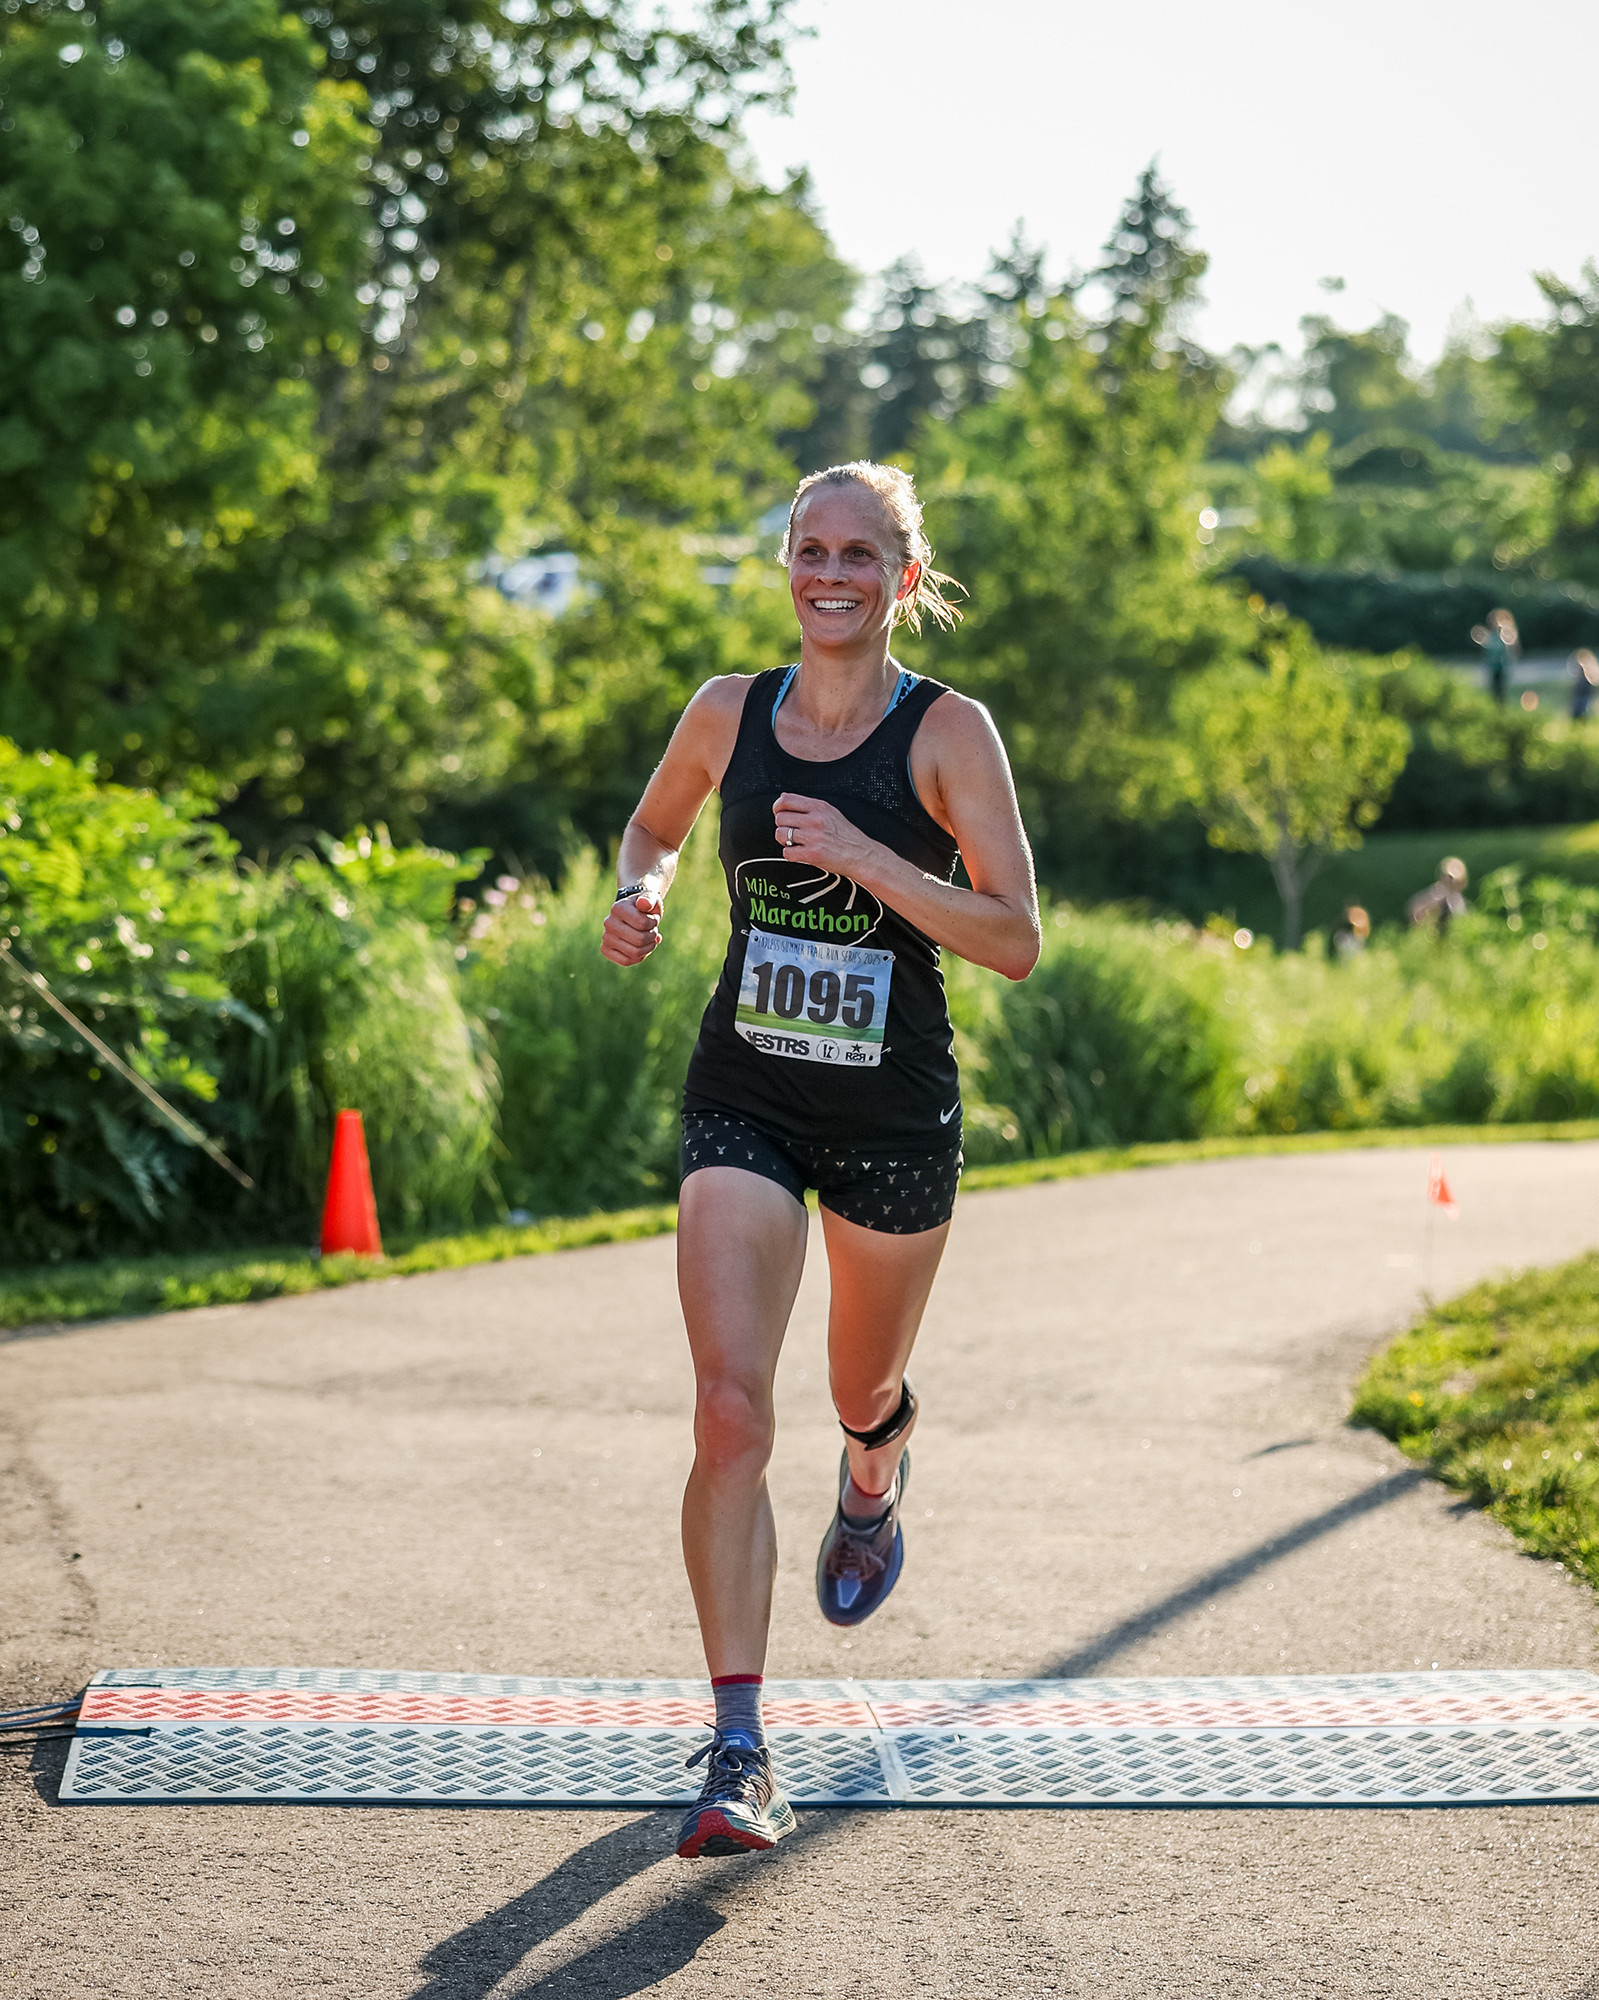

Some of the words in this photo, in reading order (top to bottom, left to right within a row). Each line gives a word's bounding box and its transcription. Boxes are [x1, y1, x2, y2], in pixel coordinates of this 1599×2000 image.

[745, 876, 778, 898] Mile
[780, 890, 790, 900] to
[750, 897, 869, 933] Marathon
[782, 940, 804, 956] SUMMER
[807, 945, 823, 959] TRAIL
[826, 947, 839, 961] RUN
[842, 950, 861, 964] SERIES
[863, 952, 881, 966] 2025
[753, 961, 875, 1029] 1095
[752, 1031, 810, 1056] ESTRS
